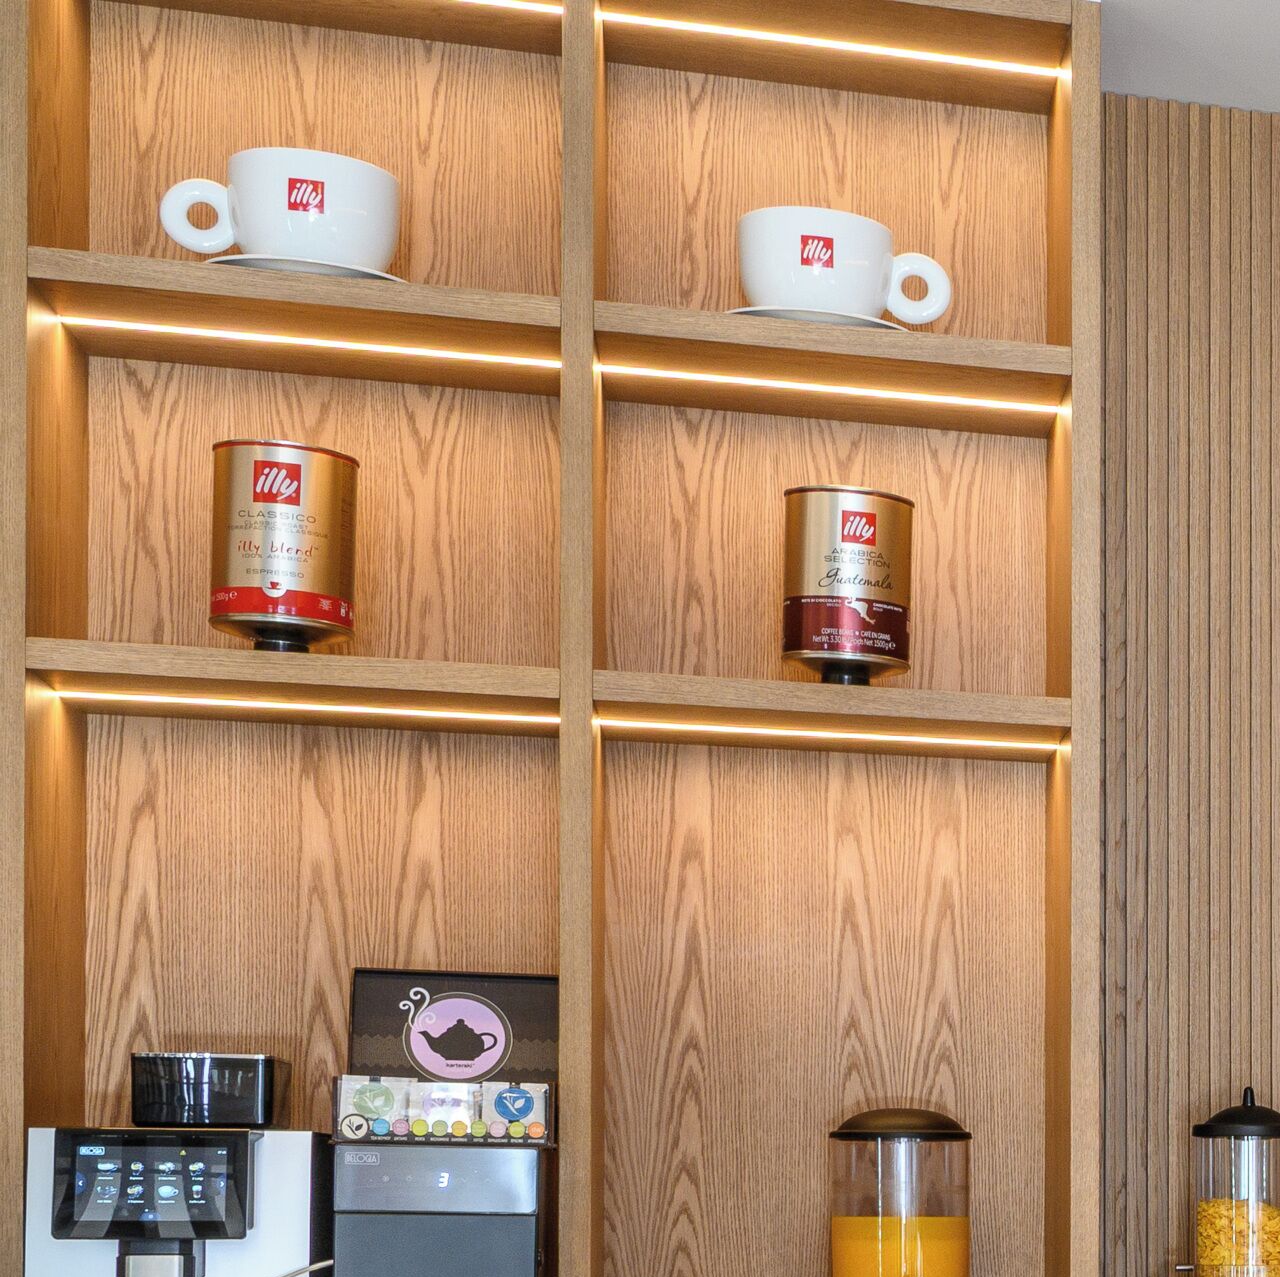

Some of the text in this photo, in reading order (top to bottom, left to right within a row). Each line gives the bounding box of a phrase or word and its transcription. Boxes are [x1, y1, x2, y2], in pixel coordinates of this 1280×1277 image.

[290, 182, 323, 210] illy
[803, 238, 832, 264] illy
[255, 467, 299, 501] illy
[237, 509, 317, 524] CLASSICO
[843, 515, 875, 542] illy
[237, 540, 314, 557] illy blend
[831, 547, 884, 560] ARABICA
[823, 555, 891, 569] SELECTION
[245, 567, 305, 579] ESPRESSO
[818, 567, 895, 591] Guatemala
[345, 1154, 377, 1163] BELOGIA
[438, 1172, 450, 1188] 3
